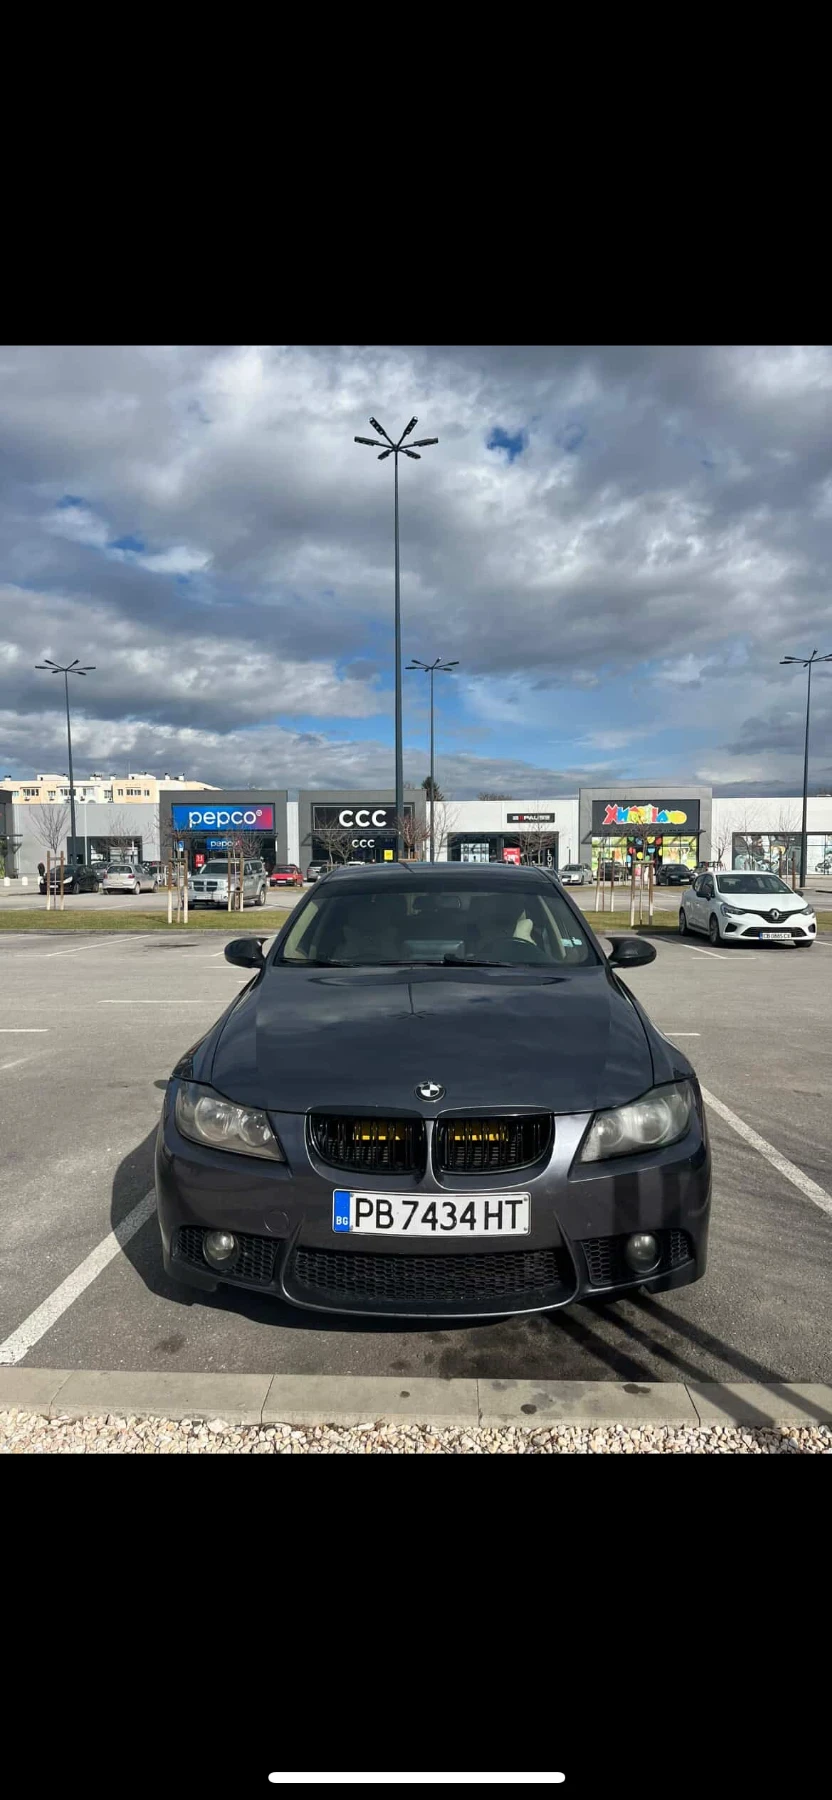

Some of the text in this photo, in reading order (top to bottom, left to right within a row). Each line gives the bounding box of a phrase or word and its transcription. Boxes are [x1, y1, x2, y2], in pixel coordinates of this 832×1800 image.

[338, 809, 387, 827] CCC
[351, 839, 375, 848] CCC
[336, 1216, 348, 1225] BG
[355, 1198, 523, 1231] PB 7434 HT
